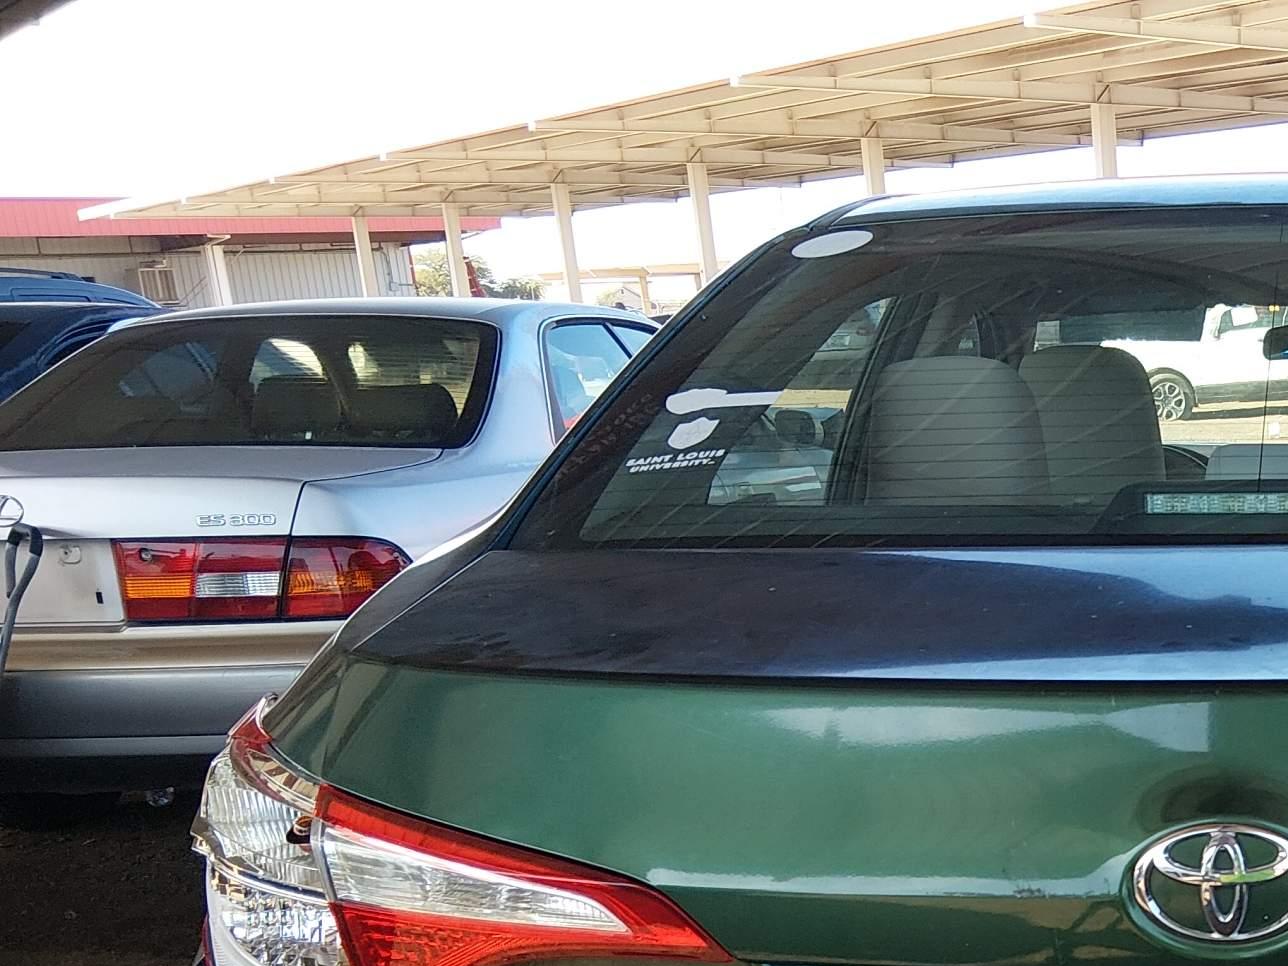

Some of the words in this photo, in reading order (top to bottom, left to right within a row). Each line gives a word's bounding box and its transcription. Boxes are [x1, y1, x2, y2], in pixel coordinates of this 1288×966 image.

[626, 454, 671, 466] SAINT
[676, 449, 726, 461] LOUIS
[196, 513, 226, 527] ES
[229, 512, 277, 526] 300
